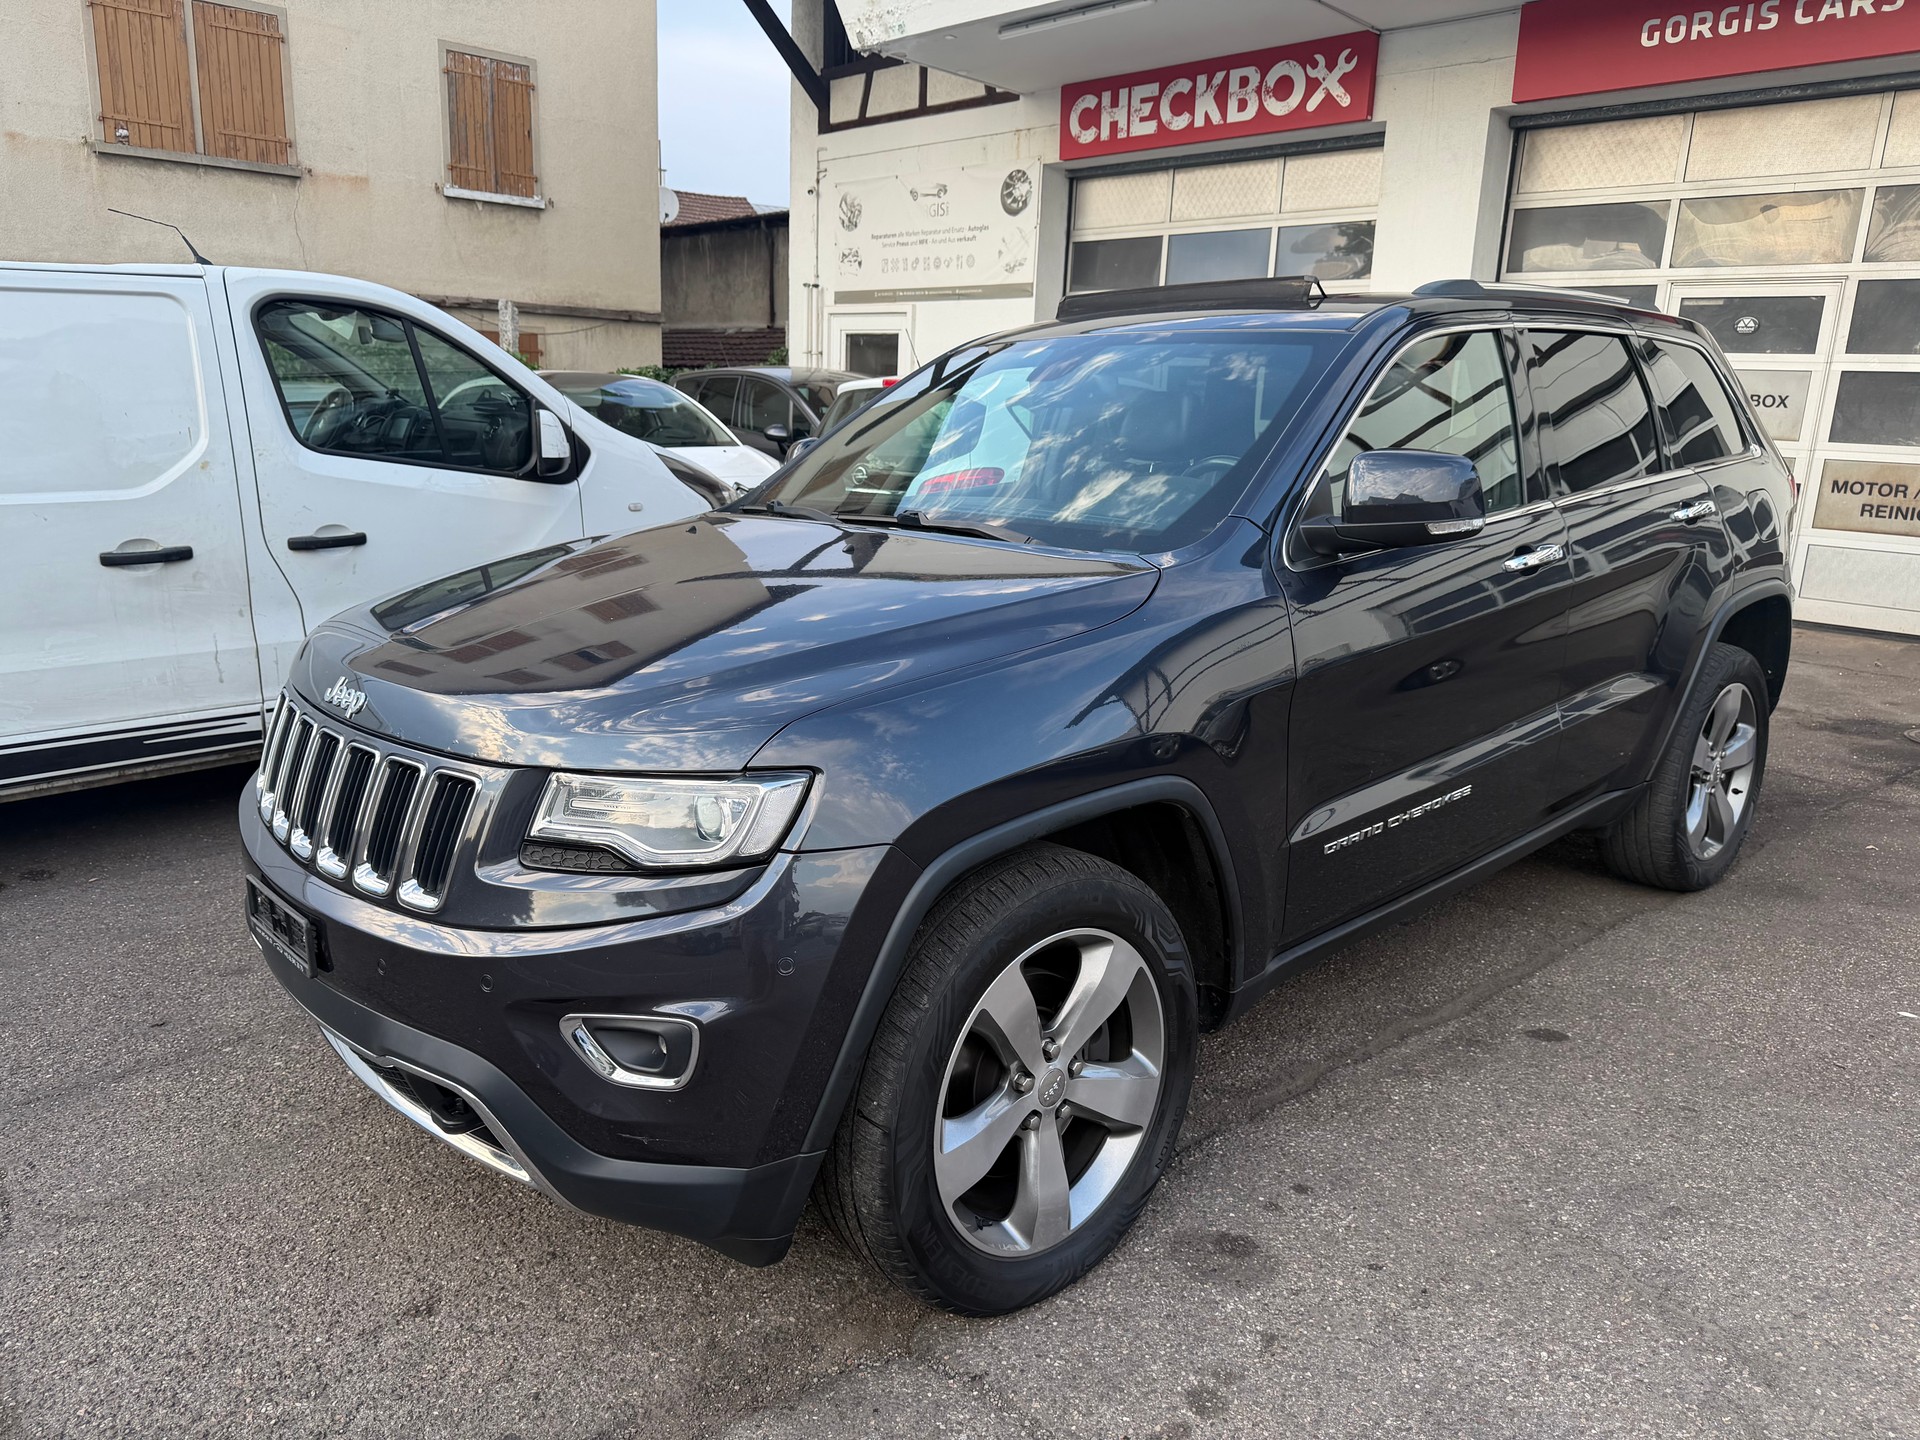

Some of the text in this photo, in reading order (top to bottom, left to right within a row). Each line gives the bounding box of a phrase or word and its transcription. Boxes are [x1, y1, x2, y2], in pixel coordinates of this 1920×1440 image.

[1640, 3, 1780, 47] GORGIS
[1069, 48, 1358, 144] CHECKBOX
[967, 224, 990, 232] Autoglas
[1750, 394, 1789, 409] BOX
[1831, 480, 1909, 498] MOTOR
[1860, 503, 1920, 521] REINI
[323, 675, 369, 720] Jeep
[1323, 784, 1473, 855] GRAND CHEROKEE
